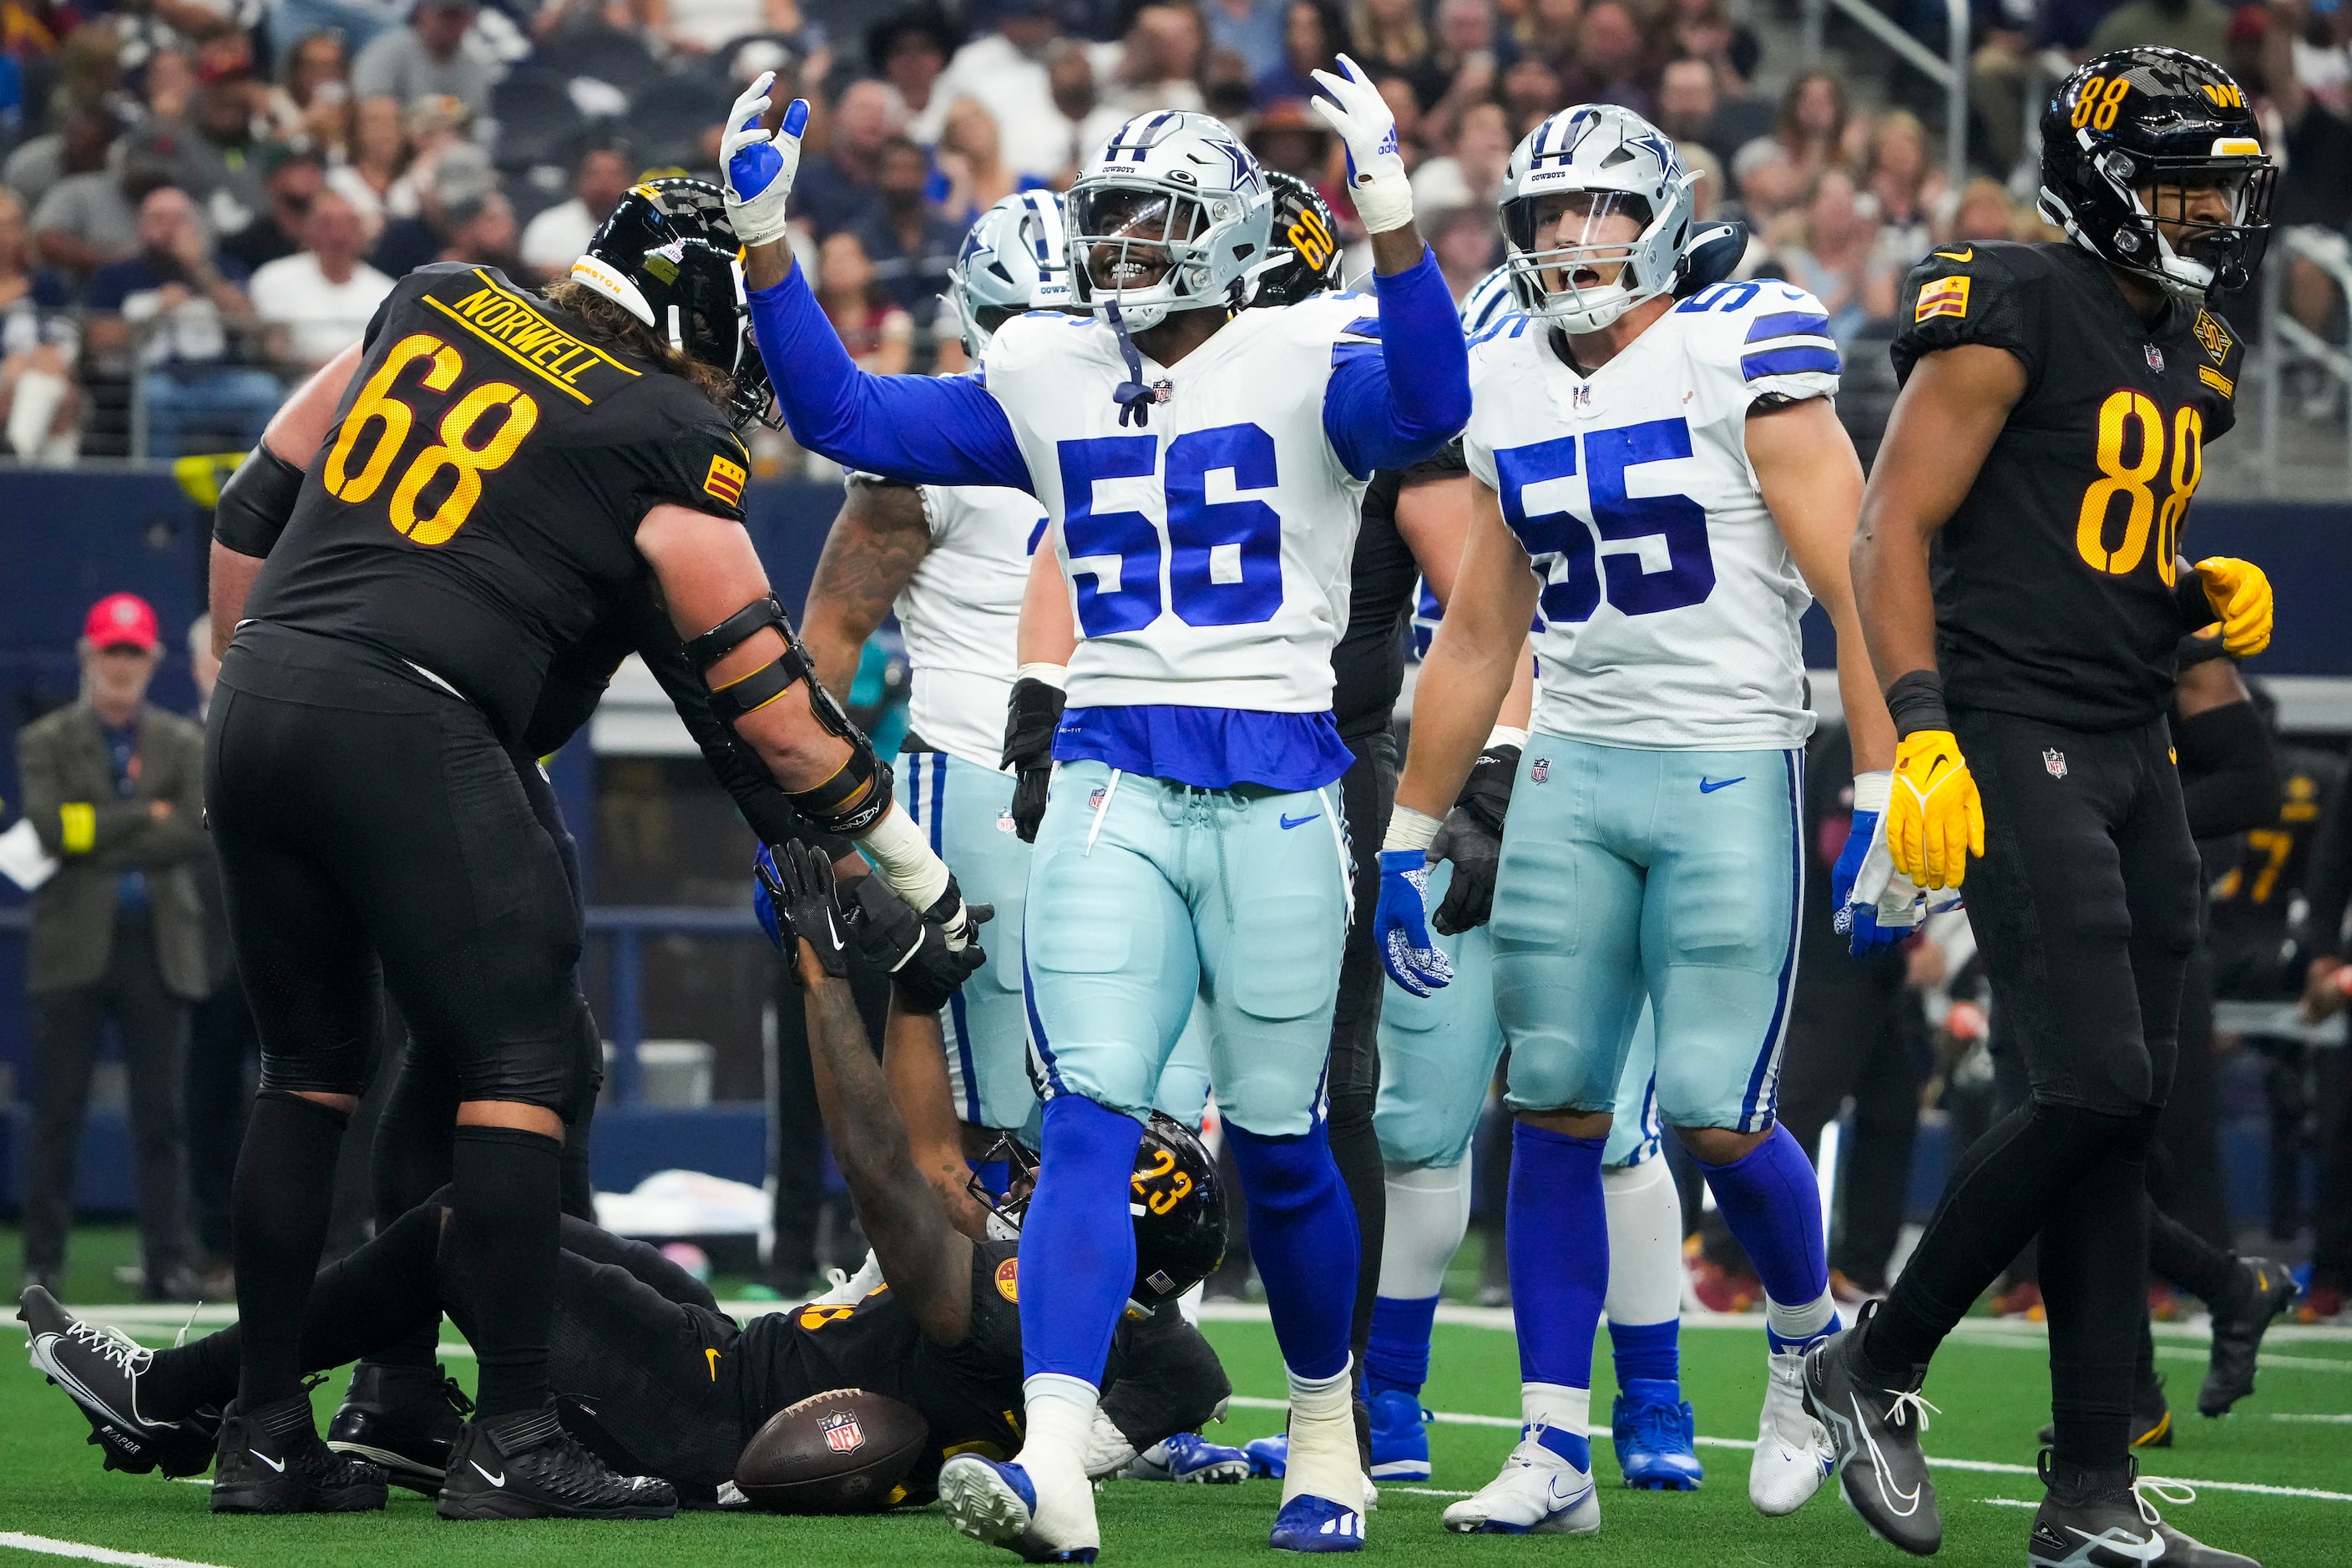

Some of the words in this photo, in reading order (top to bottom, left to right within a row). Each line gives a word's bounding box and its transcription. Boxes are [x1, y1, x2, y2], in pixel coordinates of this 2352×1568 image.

[2071, 75, 2130, 131] 88
[1531, 170, 1566, 182] COWBOYS
[1287, 209, 1334, 271] 60
[453, 287, 601, 385] NORWELL
[1155, 388, 1169, 401] NFL
[321, 331, 541, 549] 68
[2075, 387, 2204, 589] 88
[1056, 422, 1284, 640] 56
[1492, 415, 1717, 623] 55
[1532, 767, 1545, 780] NFL
[2049, 761, 2065, 774] NFL
[829, 799, 881, 832] DONJOY
[1090, 797, 1103, 809] NF
[1130, 1149, 1193, 1216] 23
[107, 1428, 141, 1454] VAPOR
[827, 1424, 862, 1449] NFL
